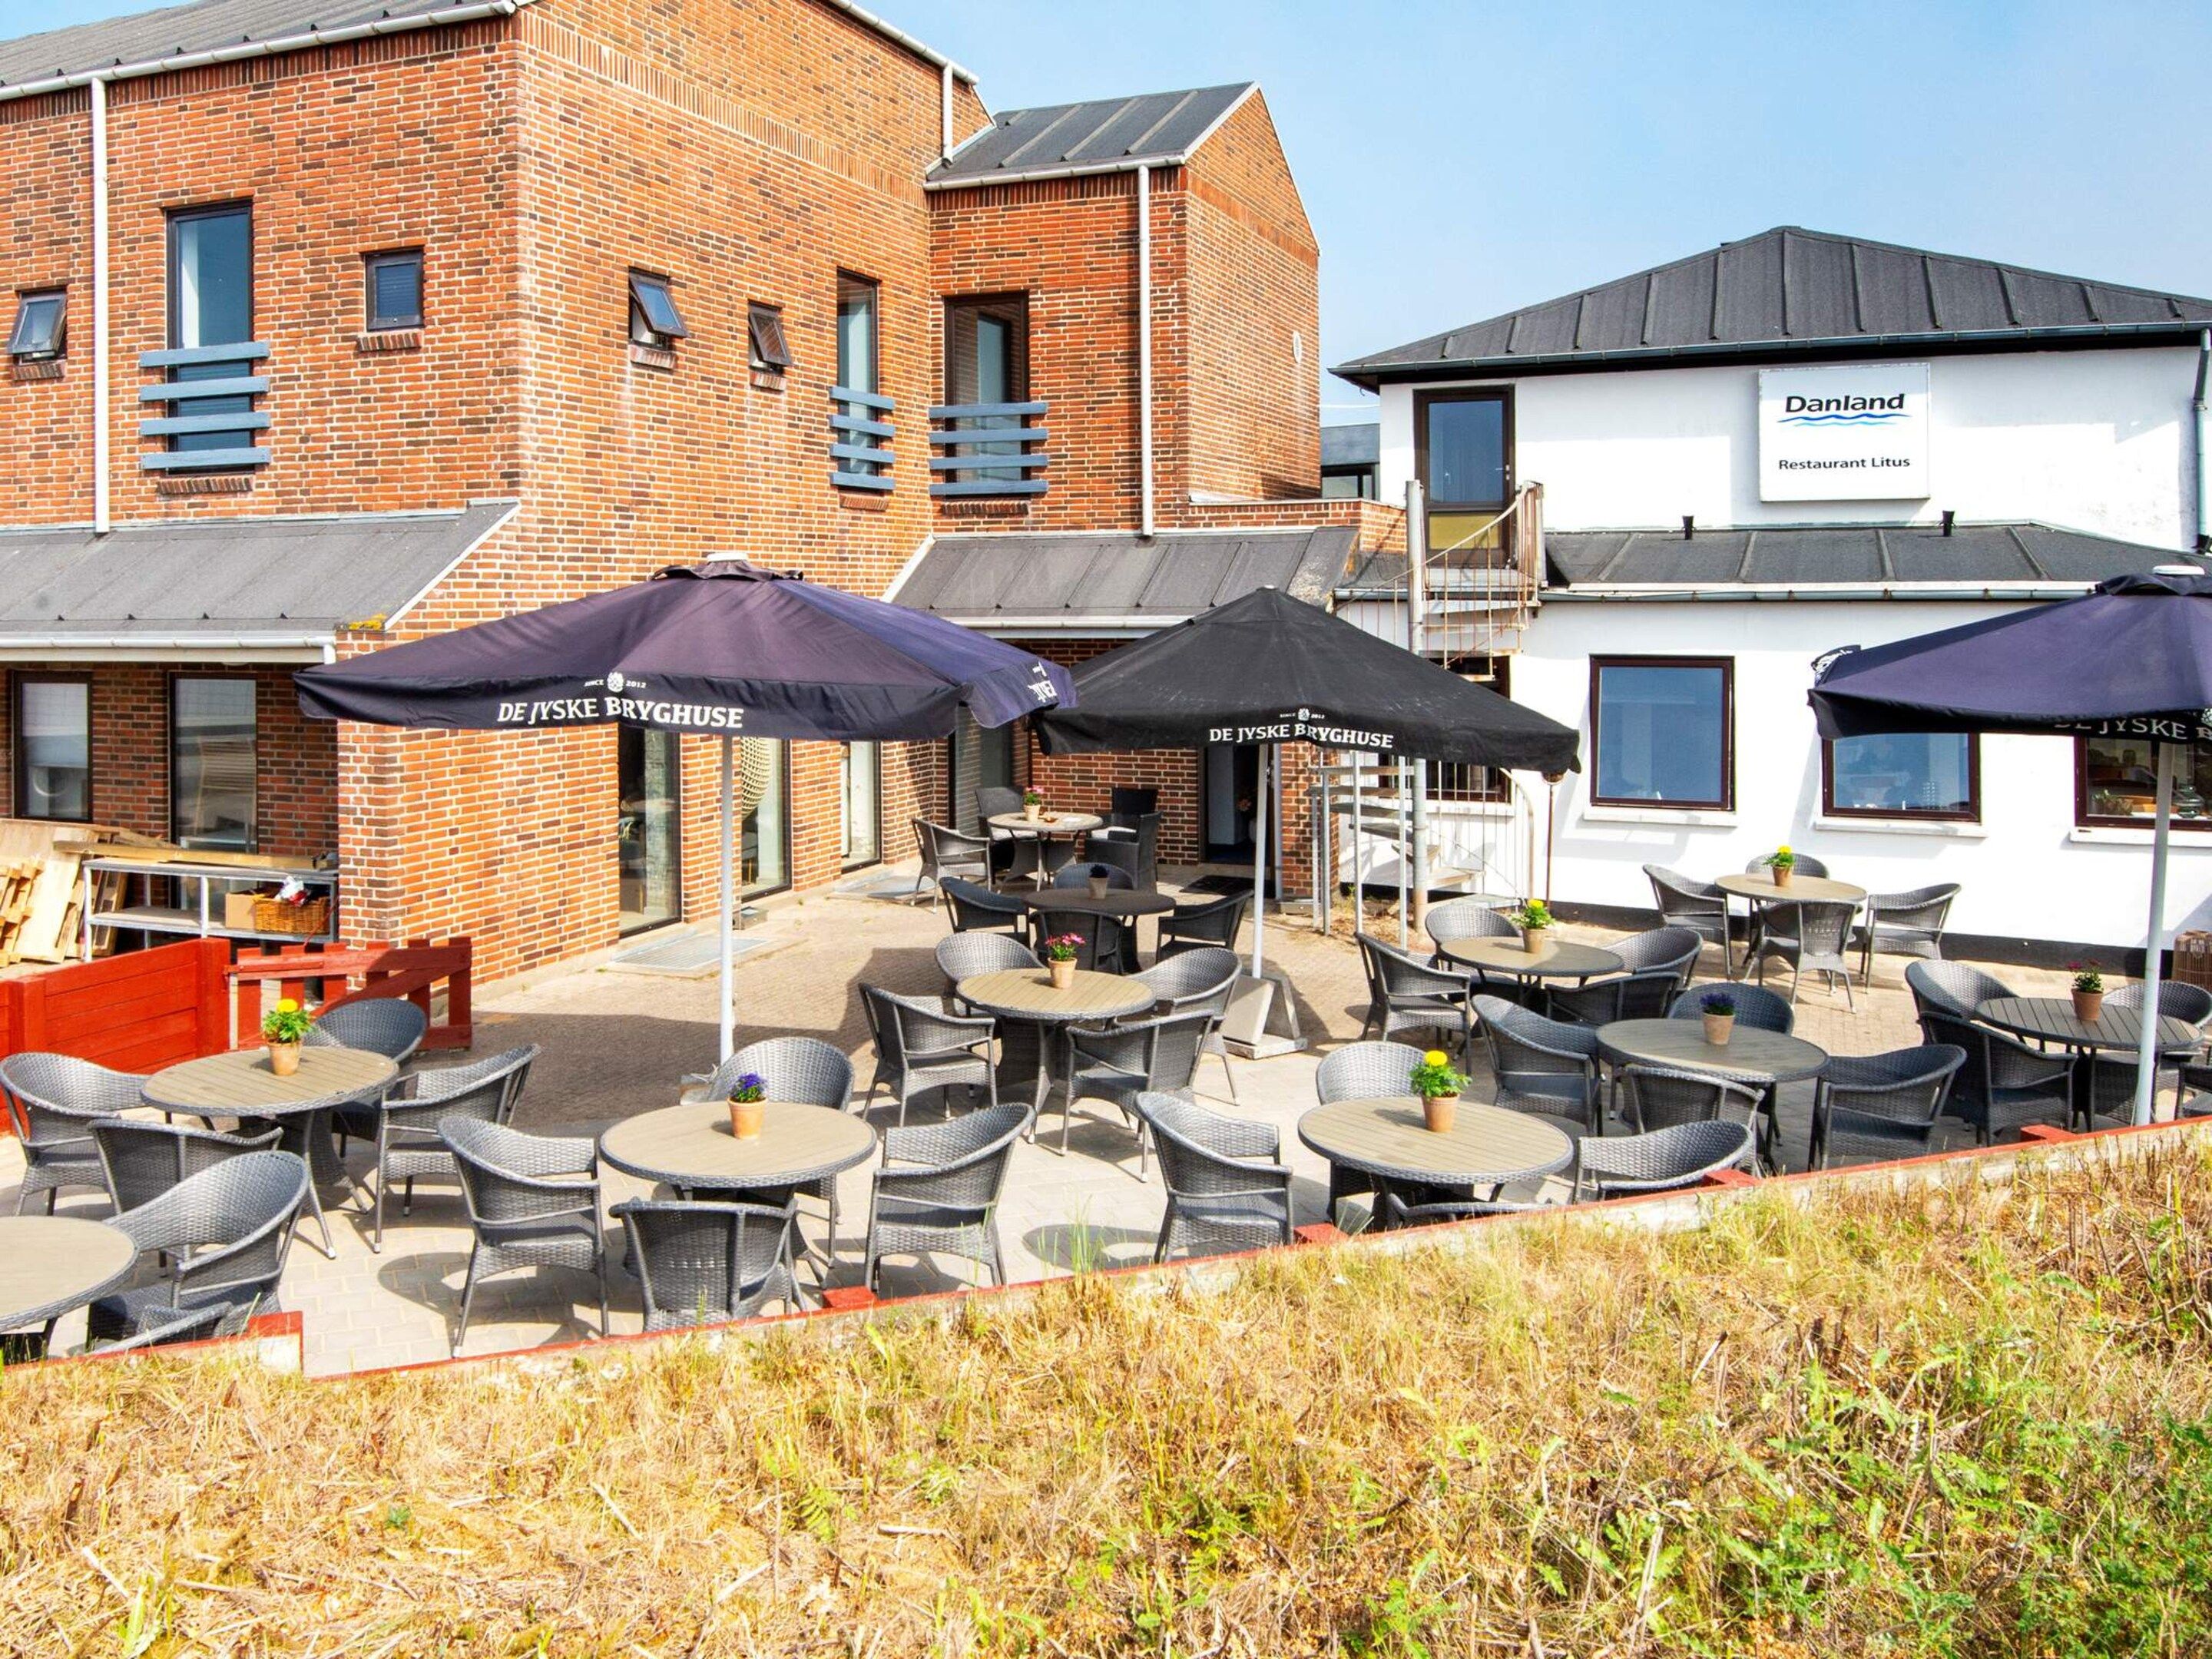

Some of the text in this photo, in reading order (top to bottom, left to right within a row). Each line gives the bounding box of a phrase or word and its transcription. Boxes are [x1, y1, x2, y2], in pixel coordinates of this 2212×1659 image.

[1785, 393, 1905, 412] Danland
[1779, 457, 1910, 469] Restaurant Litus
[497, 697, 744, 728] DE JYSKE BRYGHUSE
[1209, 723, 1394, 749] DE JYSKE BRYGHUSE
[2099, 717, 2188, 740] JYSKE
